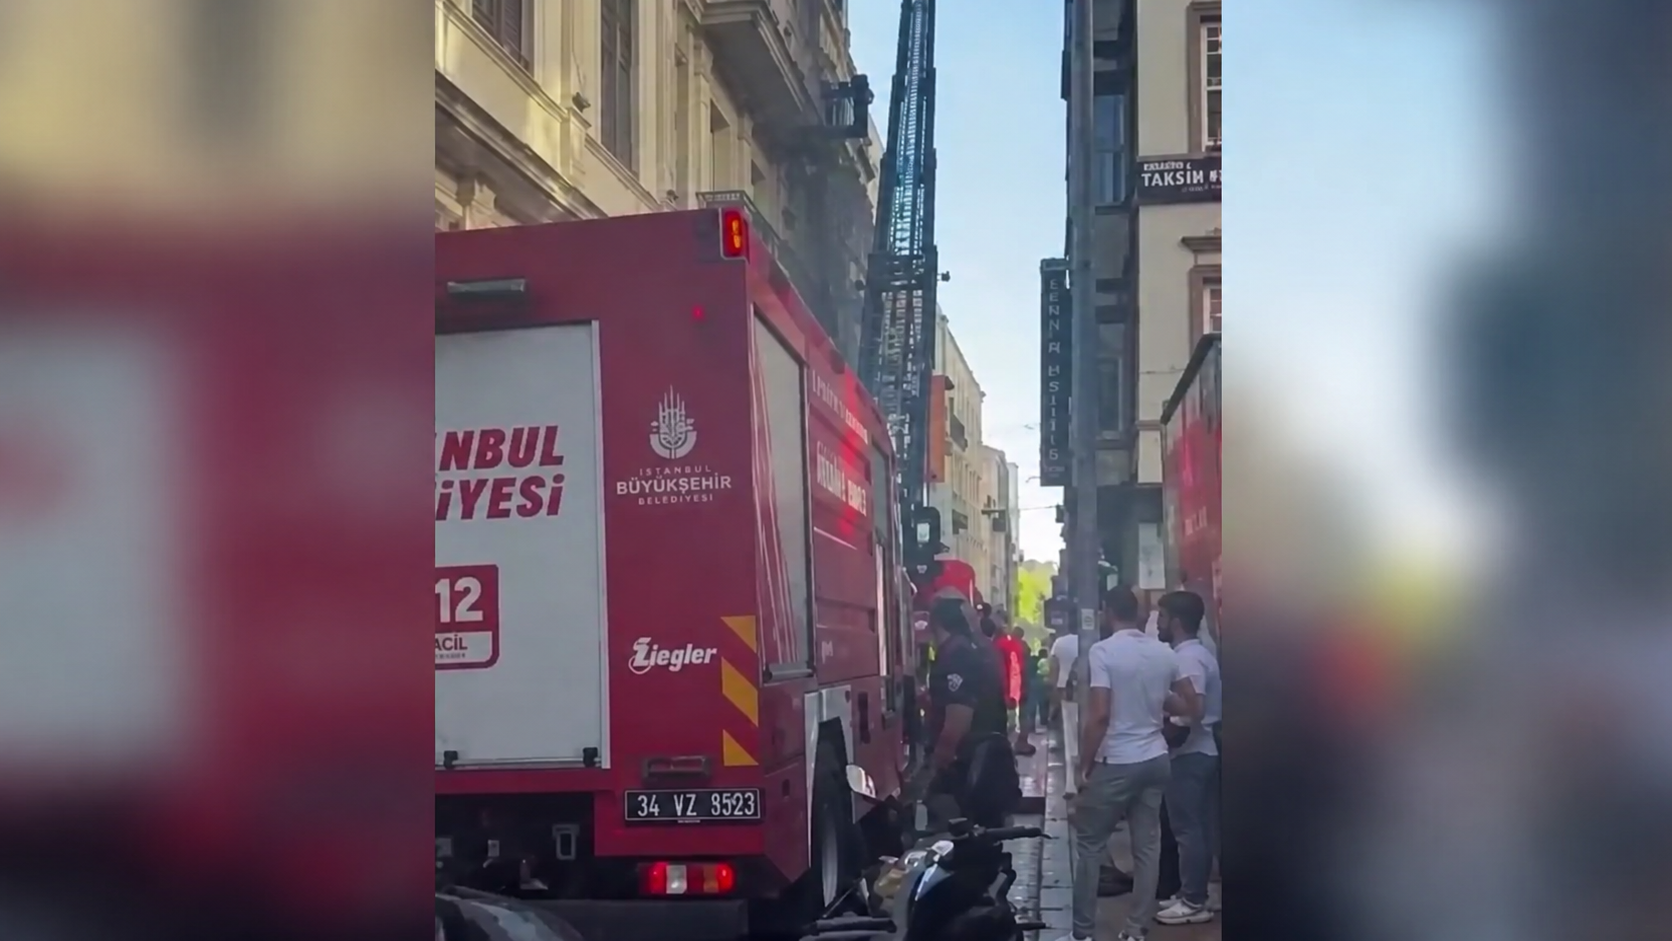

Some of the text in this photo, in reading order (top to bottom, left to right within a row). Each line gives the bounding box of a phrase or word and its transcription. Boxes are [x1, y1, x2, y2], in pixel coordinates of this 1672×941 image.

[435, 425, 565, 472] NBUL
[435, 473, 566, 521] İYESİ
[616, 472, 732, 495] BÜYÜKŞEHİR
[628, 636, 718, 675] Ziegler
[637, 794, 661, 817] 34
[673, 793, 698, 817] VZ
